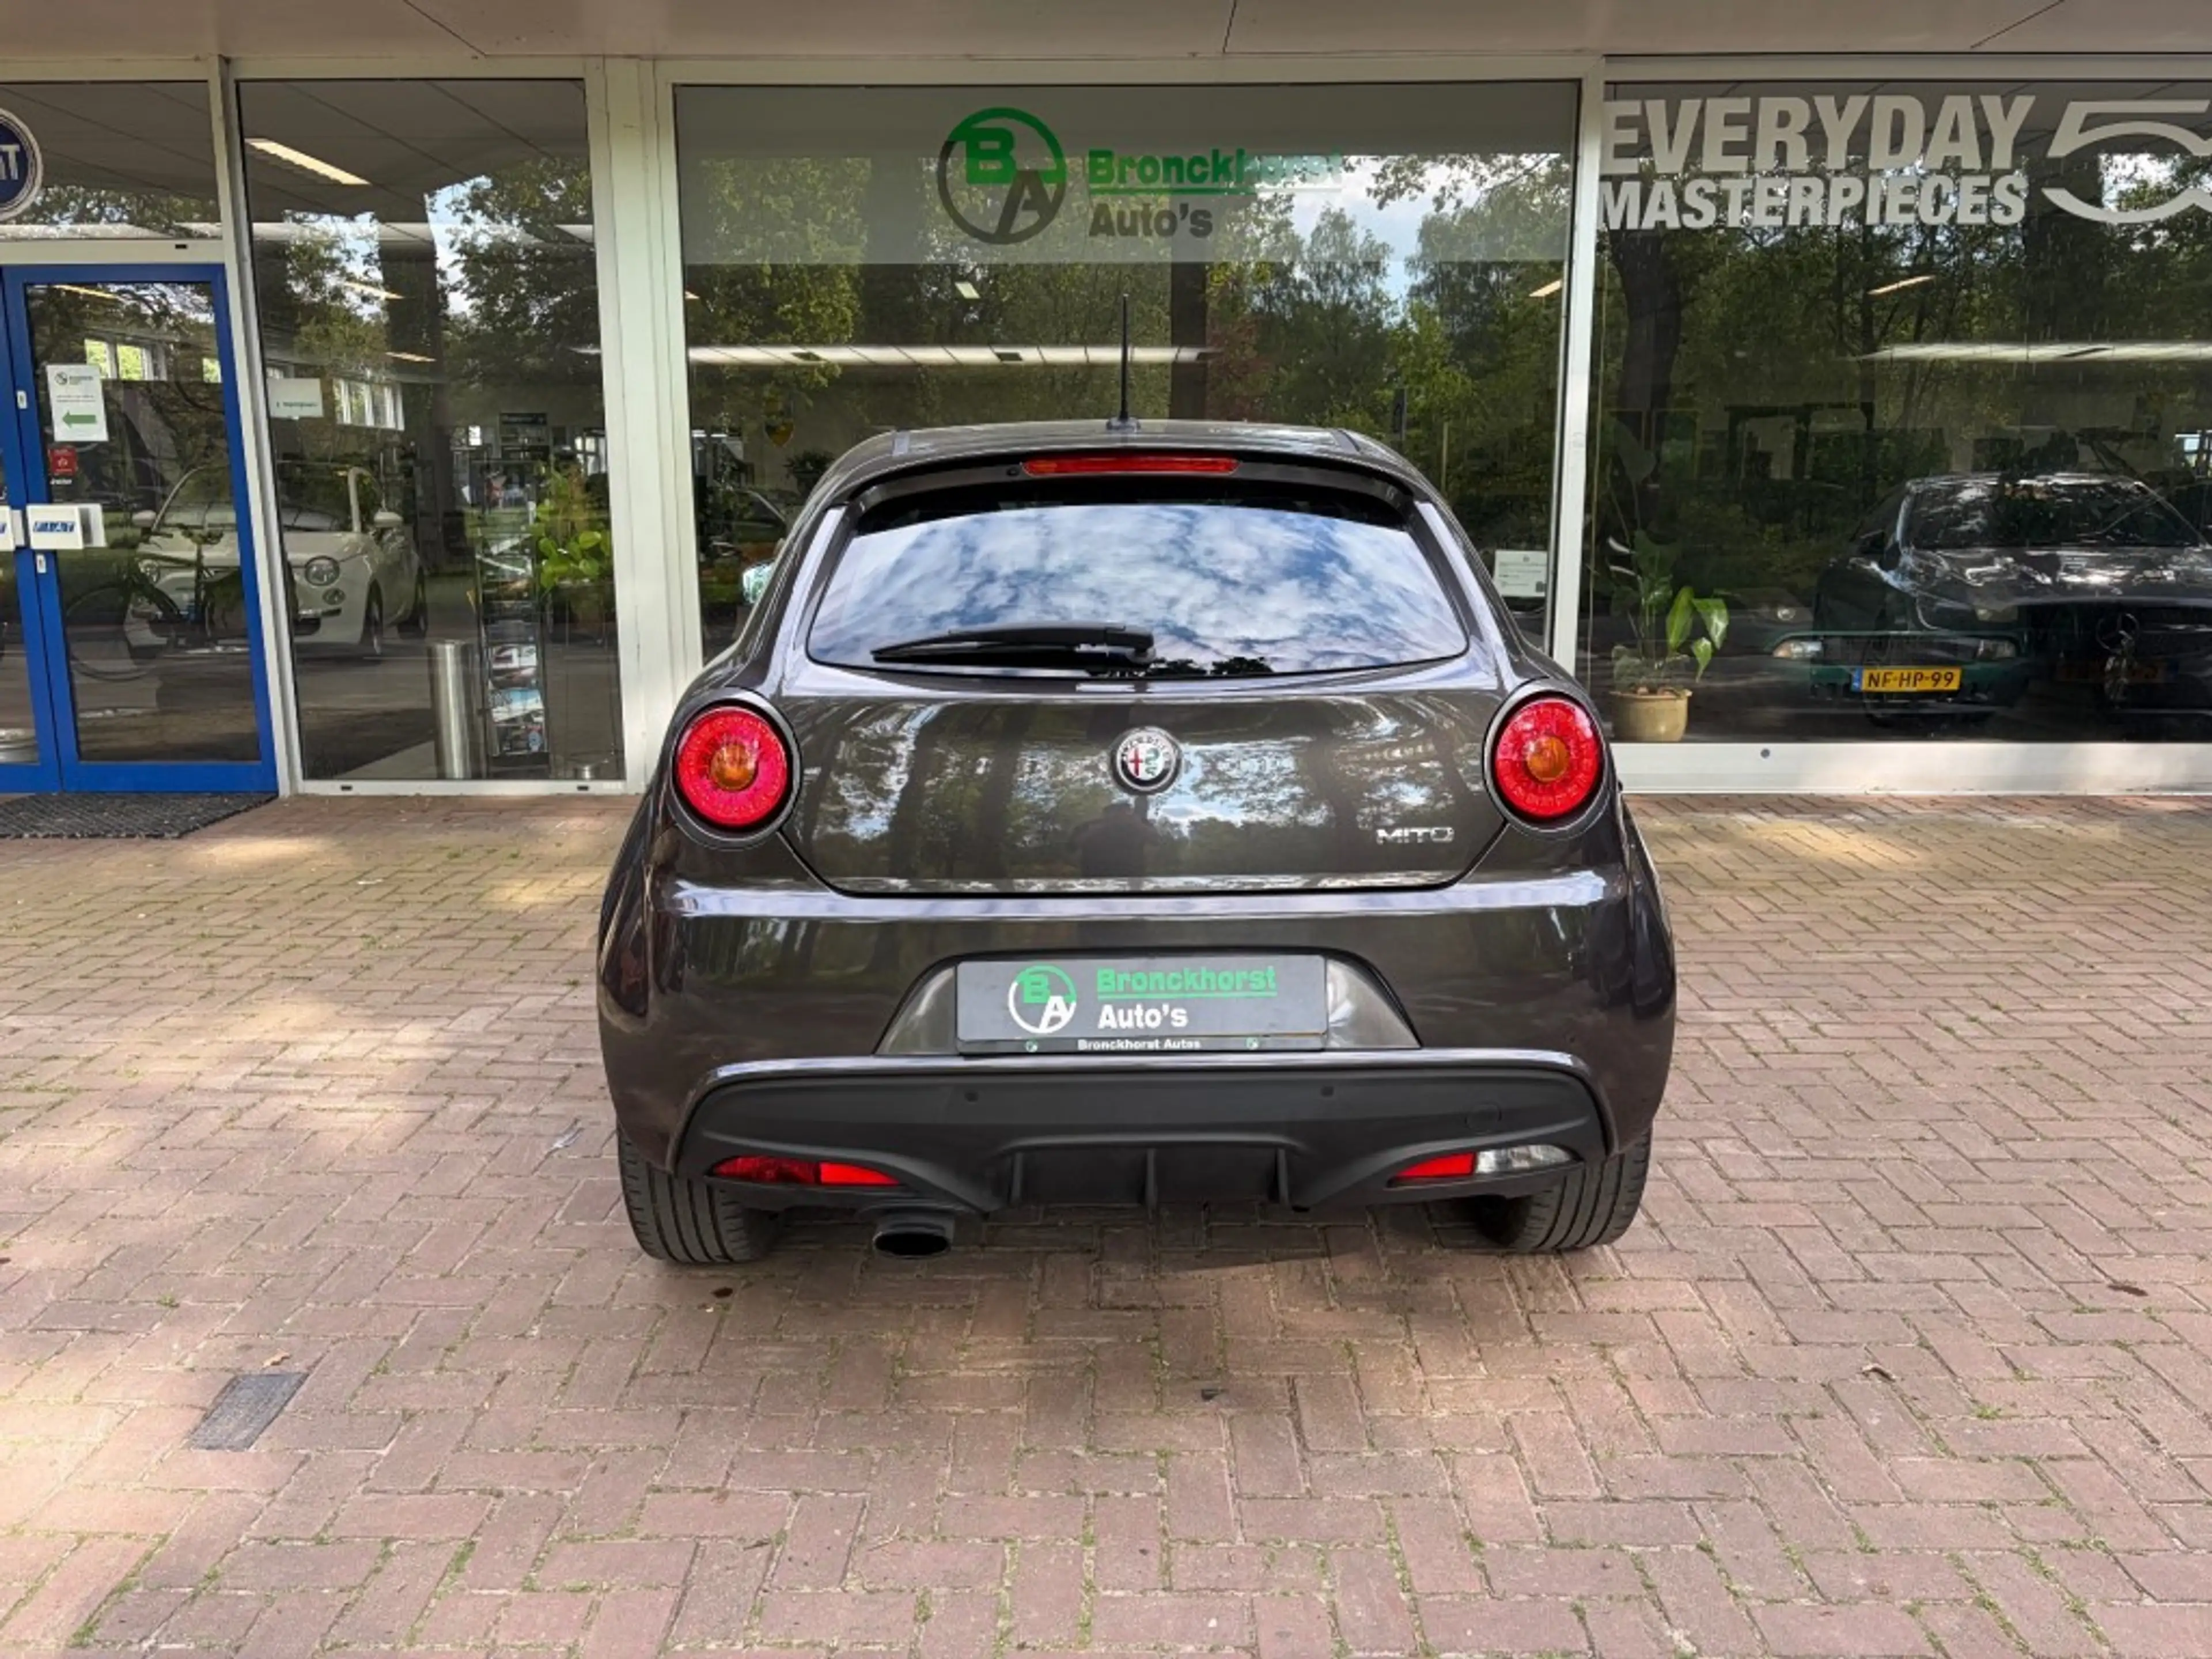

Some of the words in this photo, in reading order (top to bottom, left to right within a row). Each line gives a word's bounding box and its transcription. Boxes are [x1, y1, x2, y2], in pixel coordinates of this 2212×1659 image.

[1599, 95, 2036, 174] EVERYDAY
[2041, 99, 2212, 224] 5
[1597, 175, 2029, 230] MASTERPIECES
[1089, 203, 1213, 237] Auto's
[1868, 671, 1955, 688] NF-HP-99
[1097, 965, 1277, 993] Bronckhorst
[1098, 1003, 1189, 1029] Auto's
[1078, 1039, 1159, 1051] Bronckhorst
